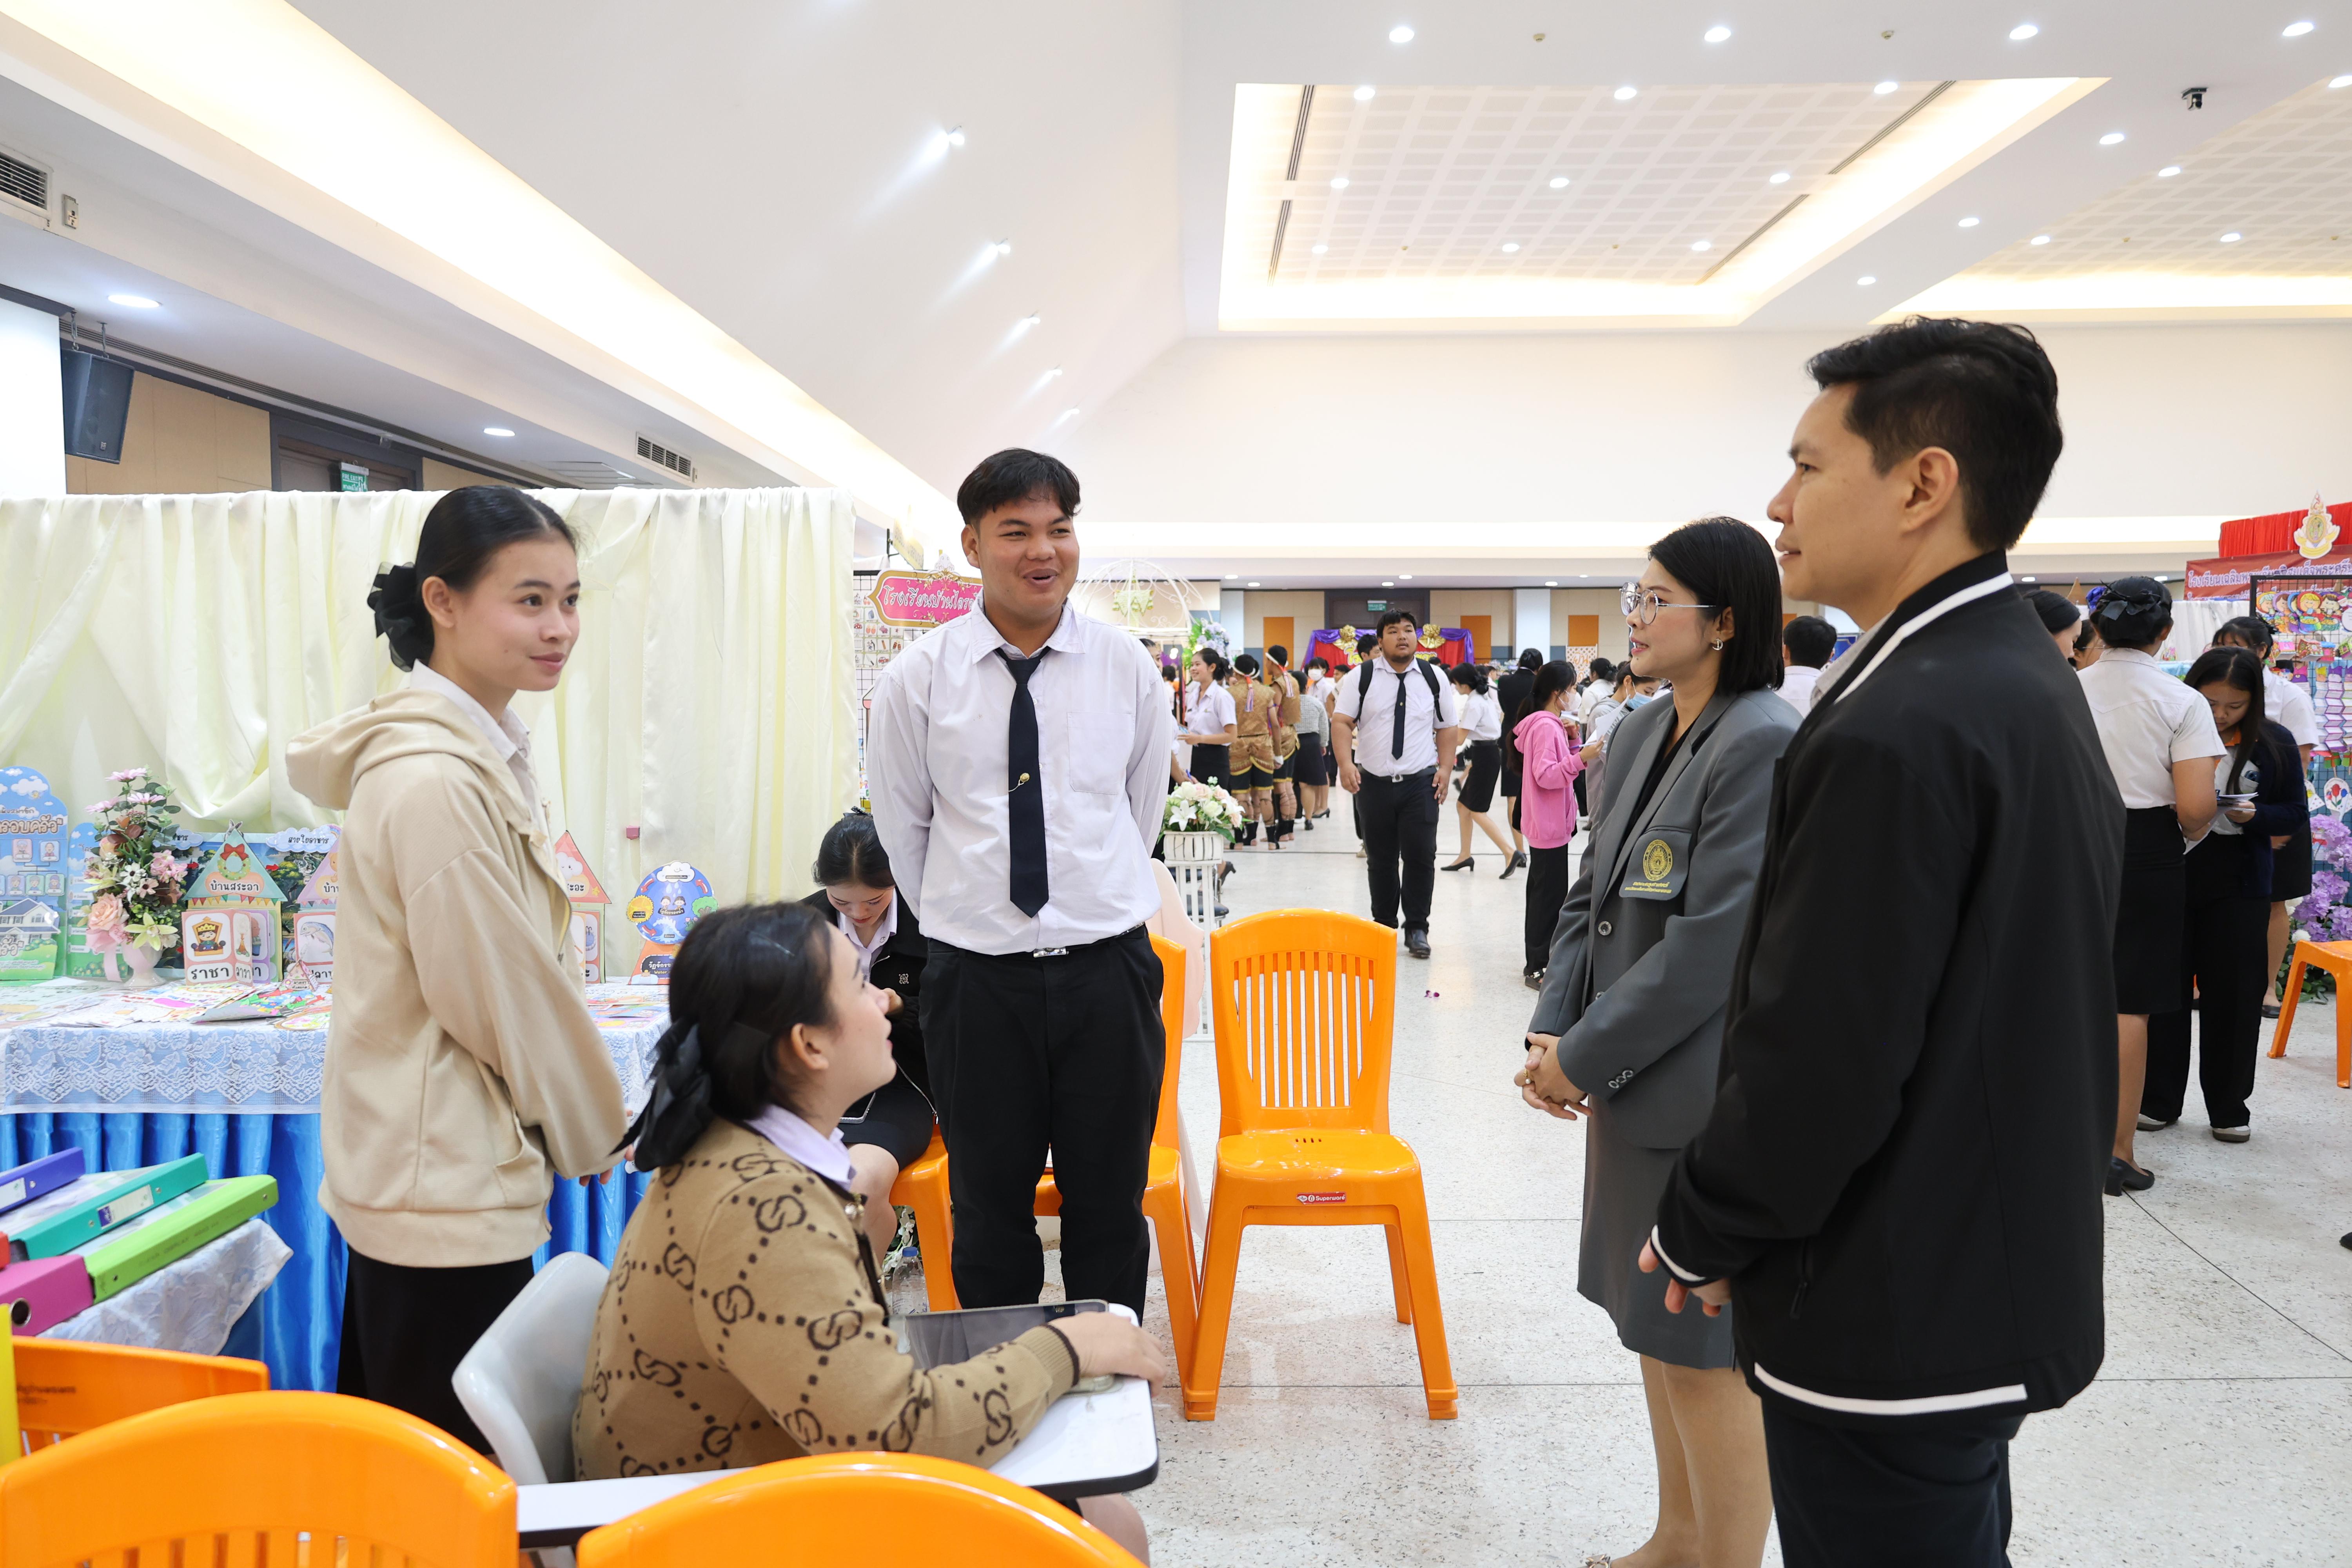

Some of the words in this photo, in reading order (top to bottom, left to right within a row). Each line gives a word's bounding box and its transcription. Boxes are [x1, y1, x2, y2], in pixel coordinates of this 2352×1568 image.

[210, 879, 260, 892] บ้านสระอา
[191, 966, 229, 980] ราชา
[236, 966, 251, 980] ลาวา
